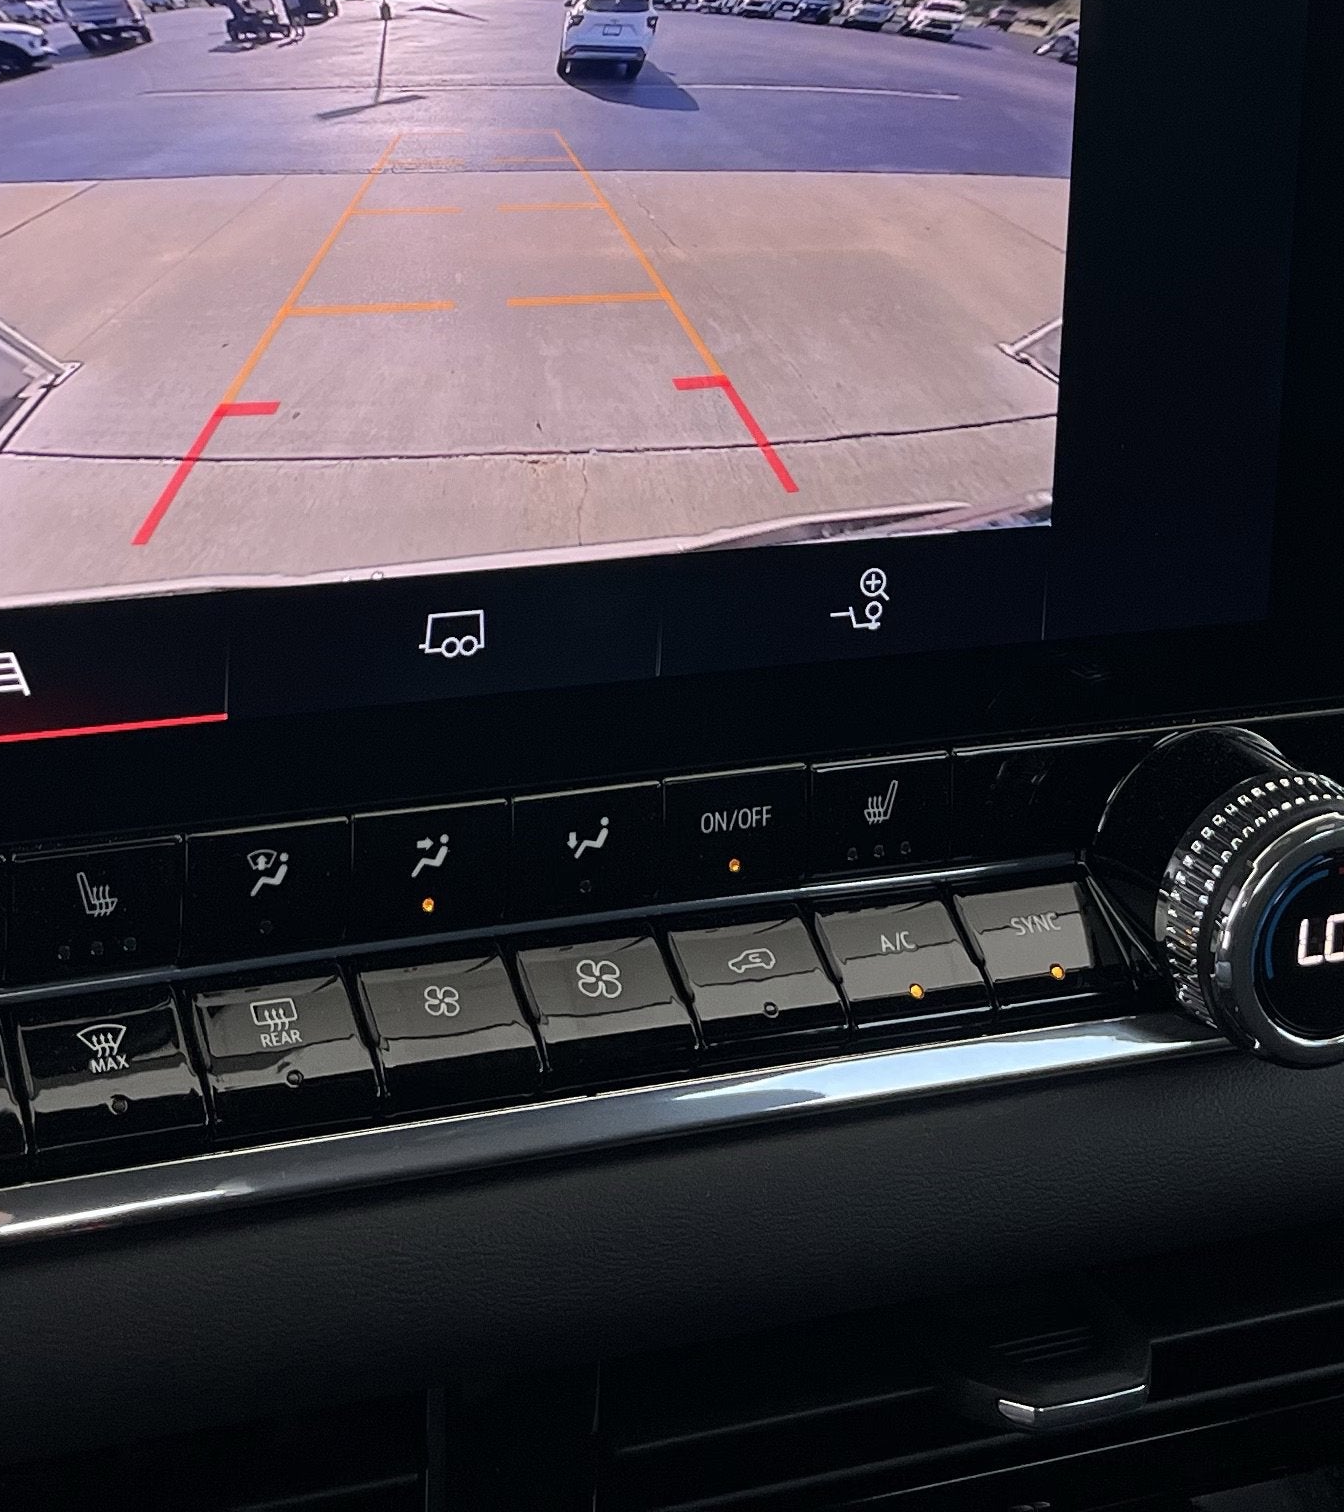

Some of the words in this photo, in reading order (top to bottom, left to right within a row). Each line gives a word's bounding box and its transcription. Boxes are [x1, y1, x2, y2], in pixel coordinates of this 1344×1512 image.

[700, 805, 772, 834] ON/OFF
[1010, 912, 1061, 936] SYNC
[880, 931, 916, 952] A/C
[260, 1029, 303, 1048] REAR
[90, 1054, 130, 1074] MAX
